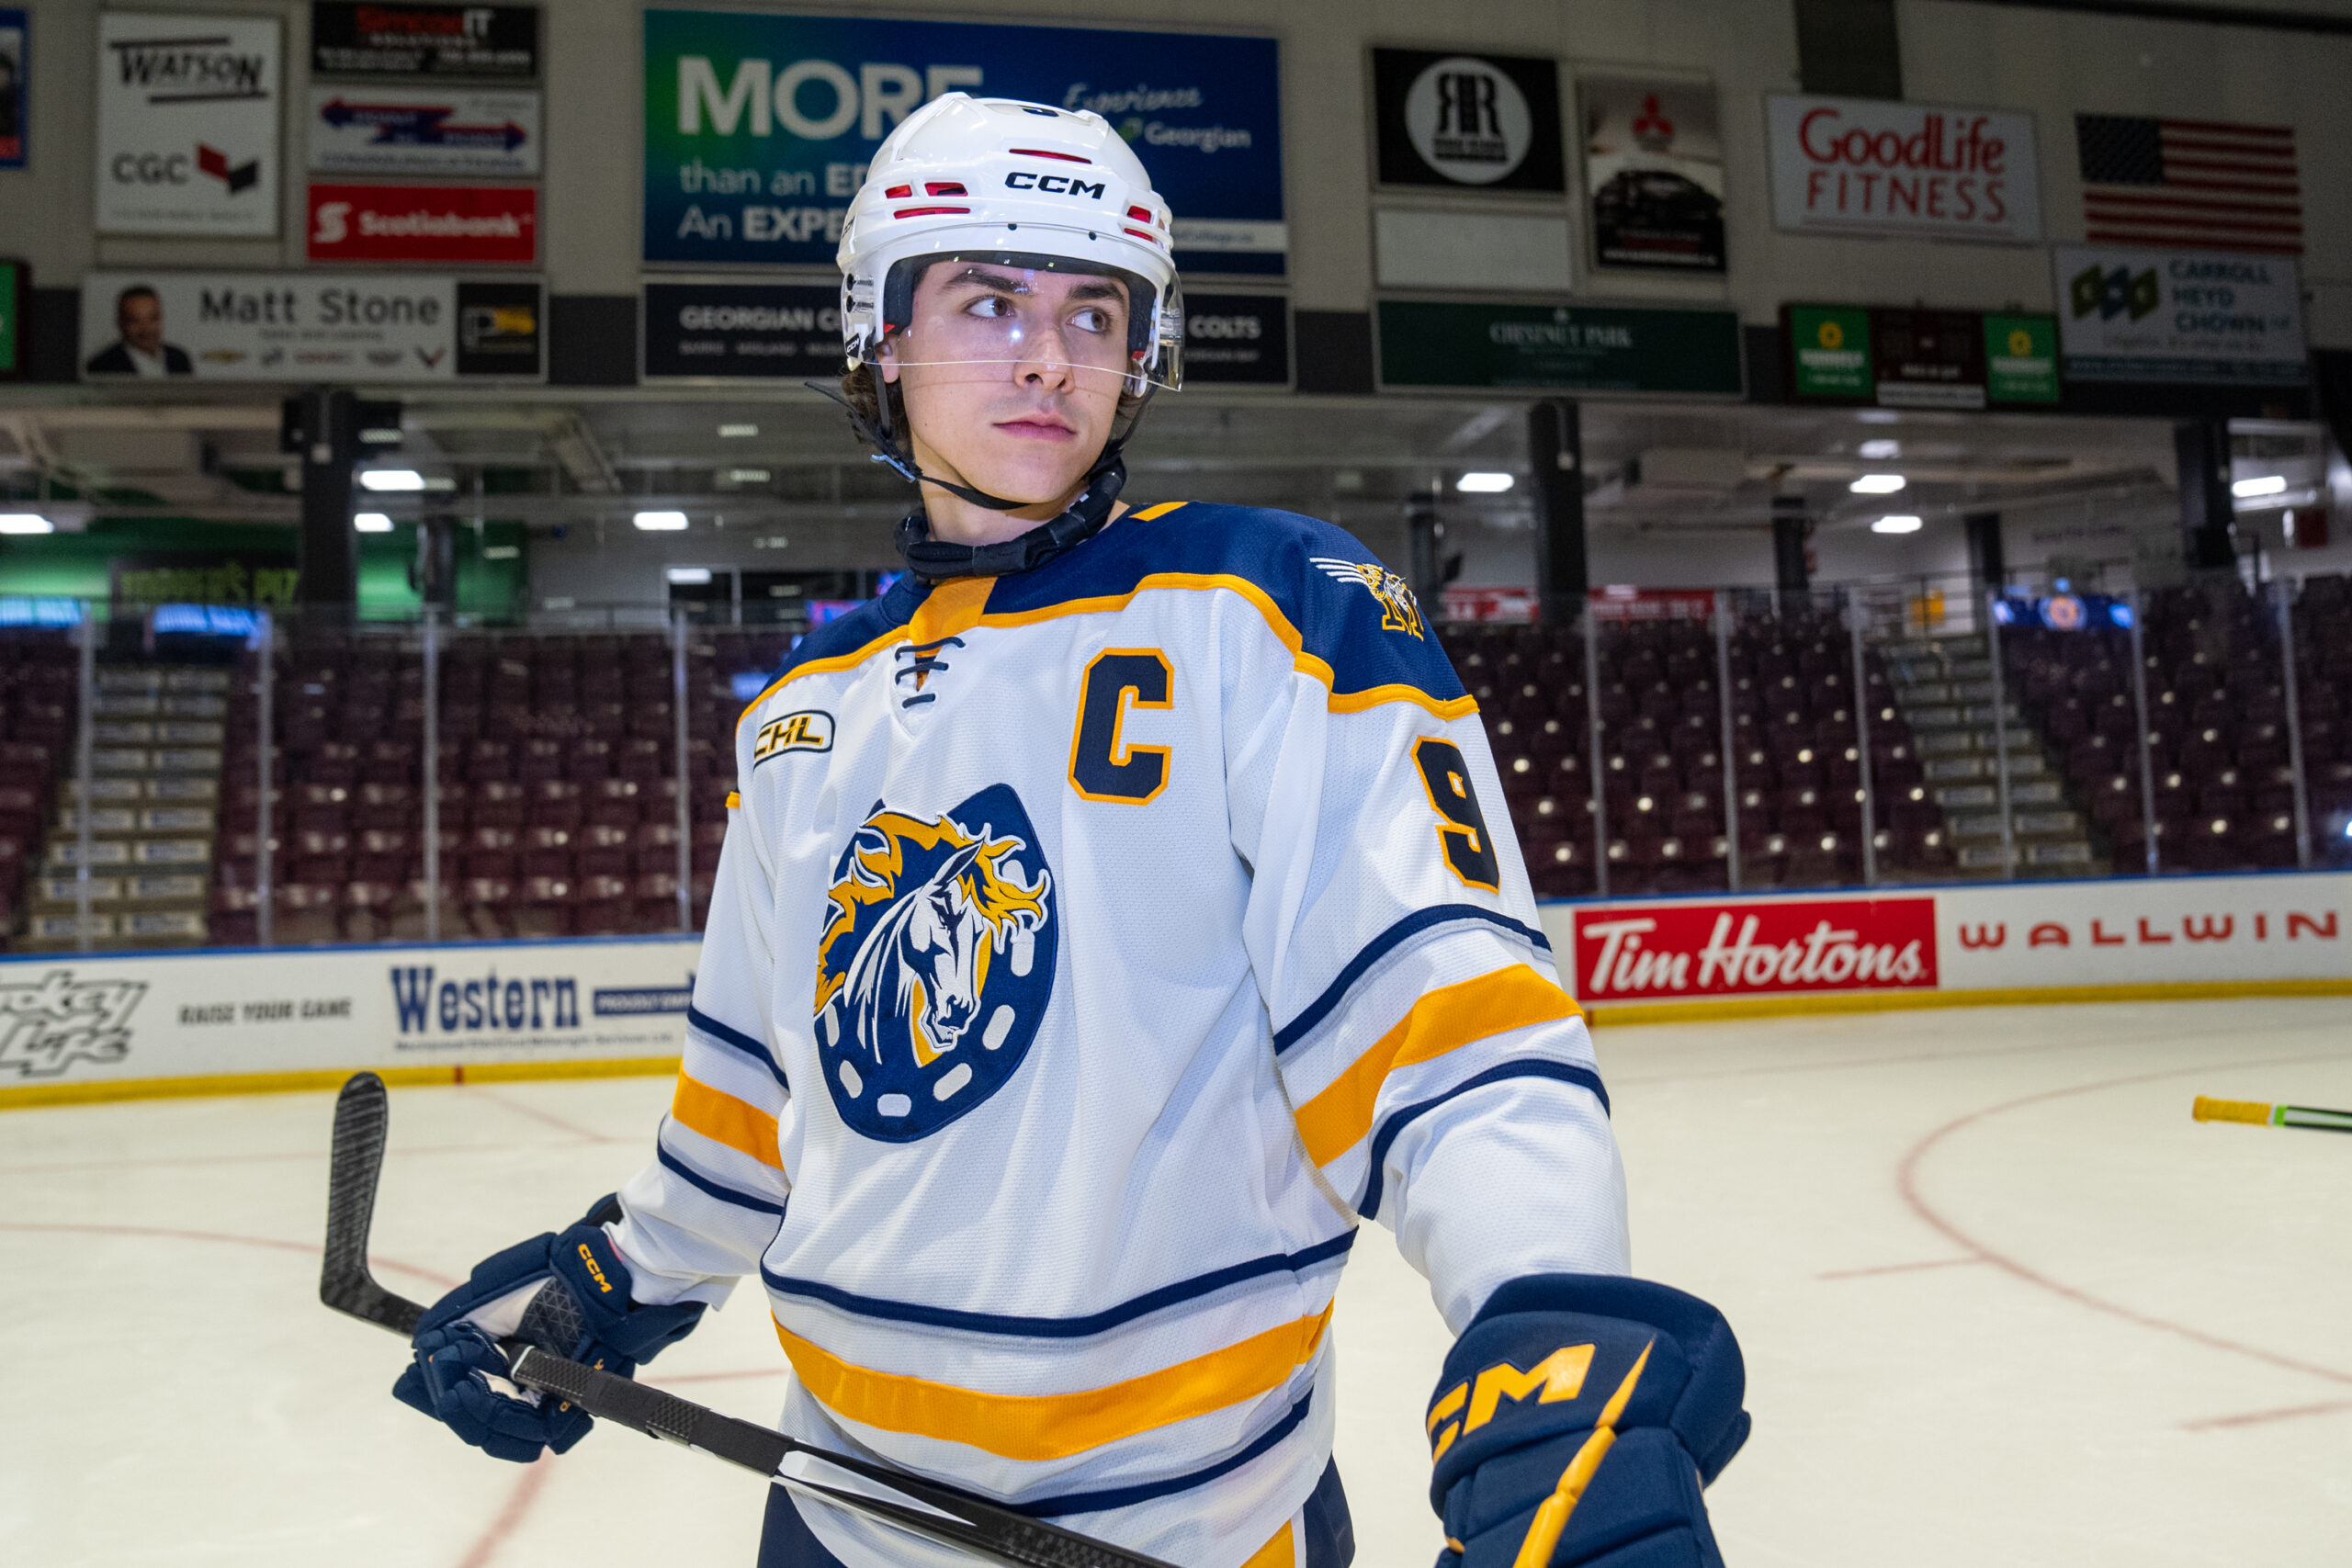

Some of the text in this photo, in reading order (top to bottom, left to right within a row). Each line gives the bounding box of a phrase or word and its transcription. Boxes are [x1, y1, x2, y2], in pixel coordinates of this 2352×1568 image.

[119, 48, 265, 91] WATSON
[1063, 83, 1204, 114] Experience
[1145, 121, 1252, 152] Georgian
[1798, 107, 2007, 175] GoodLife
[111, 152, 192, 186] CGC
[680, 156, 761, 195] than
[770, 170, 817, 196] an
[1005, 172, 1106, 199] CCM
[1805, 169, 2007, 224] FITNESS
[358, 209, 522, 239] Scotiabank
[677, 204, 734, 241] An
[2169, 259, 2270, 284] CARROLL
[199, 288, 441, 325] Matt Stone
[2173, 288, 2234, 309] HEYD
[679, 305, 815, 332] GEORGIAN
[1188, 314, 1262, 340] COLTS
[2175, 312, 2266, 333] CHOWN
[1067, 647, 1175, 807] C
[1409, 734, 1501, 897] 9
[1959, 909, 2338, 951] WALLWIN
[1582, 911, 1923, 994] Tim Hortons
[179, 998, 353, 1026] RAISE YOUR GAME
[390, 965, 582, 1034] Western
[578, 1243, 613, 1293] CCM
